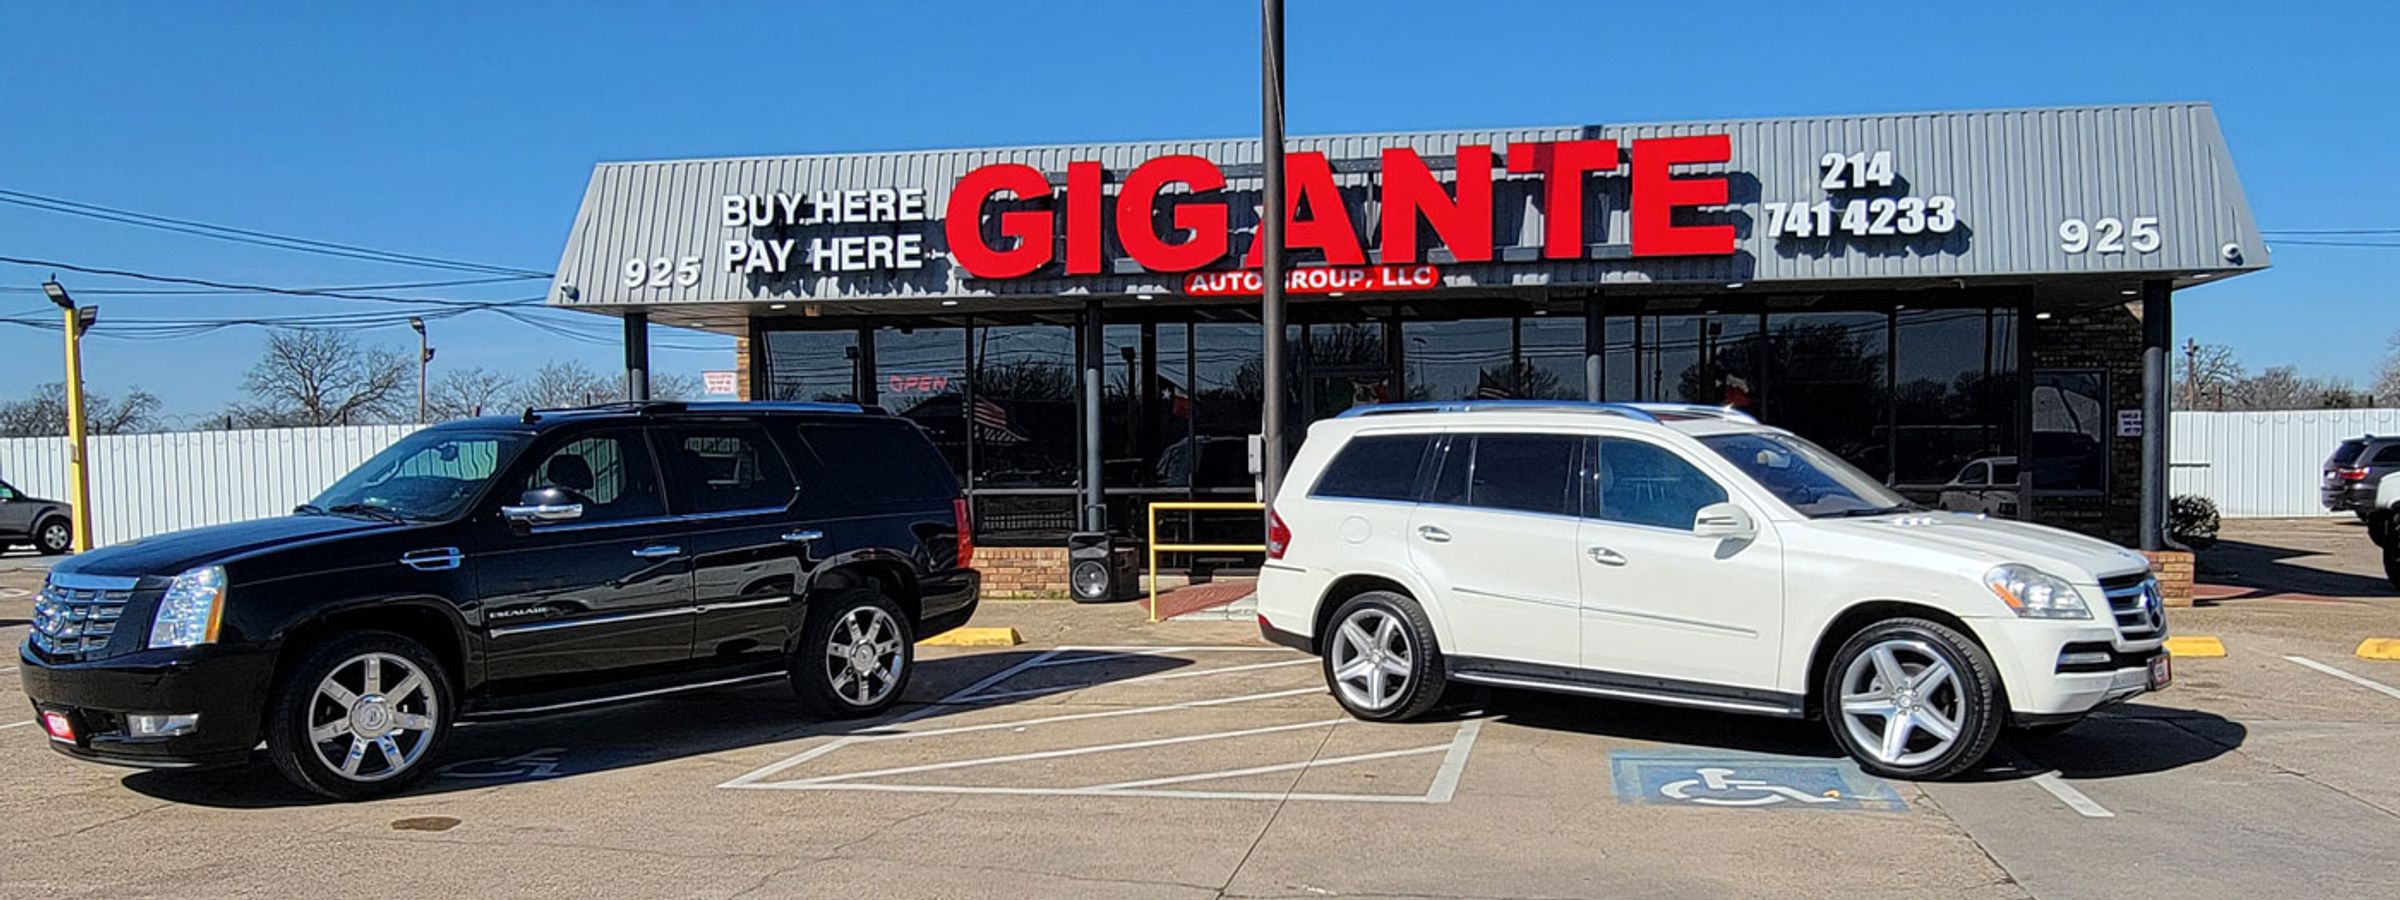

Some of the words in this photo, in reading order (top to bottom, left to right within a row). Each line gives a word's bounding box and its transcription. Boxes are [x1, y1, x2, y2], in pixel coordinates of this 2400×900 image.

[1819, 150, 1895, 190] 214
[721, 190, 802, 229] BUY
[813, 186, 925, 225] HERE
[945, 134, 1736, 280] GIGANTE
[1763, 200, 1831, 239] 741
[1840, 195, 1957, 237] 4233
[723, 238, 796, 274] PAY
[812, 233, 924, 272] HERE
[2058, 216, 2161, 255] 925
[623, 256, 702, 289] 925
[1190, 271, 1264, 292] AUTO
[1285, 268, 1373, 289] ROUP,
[1382, 266, 1432, 286] LLC
[888, 374, 948, 392] OPEN
